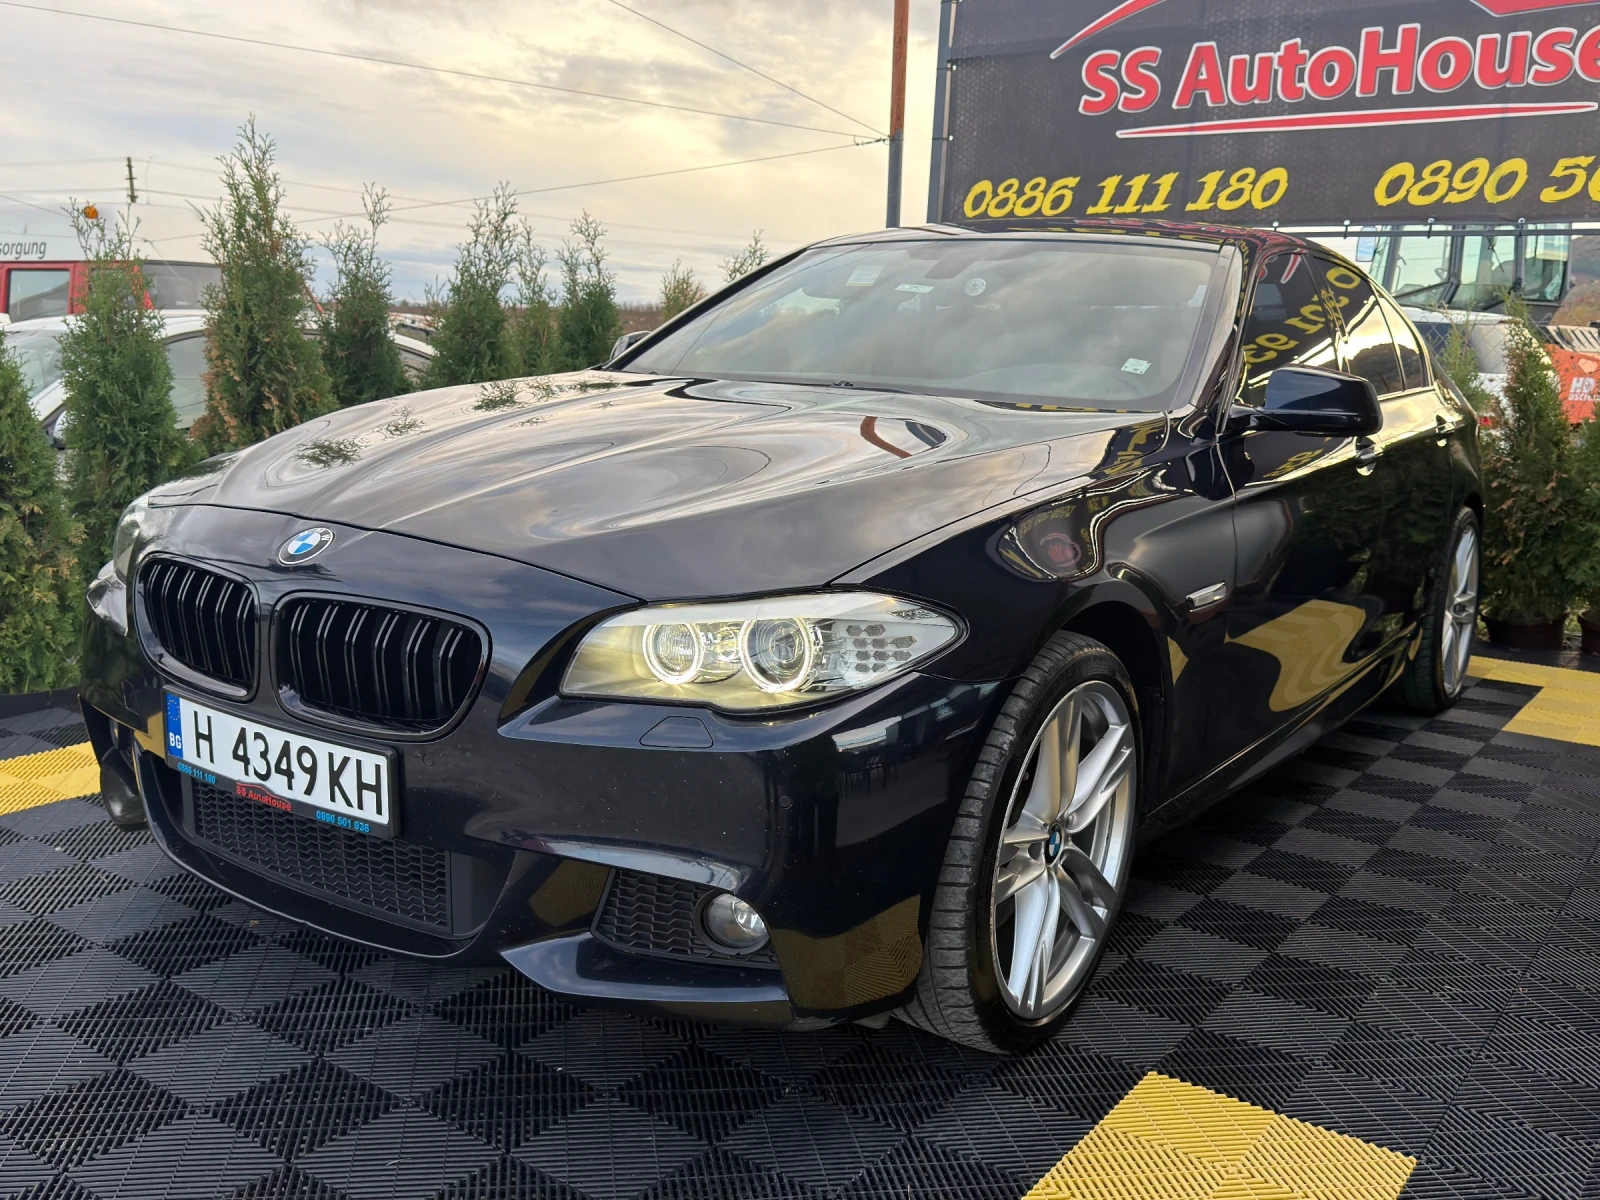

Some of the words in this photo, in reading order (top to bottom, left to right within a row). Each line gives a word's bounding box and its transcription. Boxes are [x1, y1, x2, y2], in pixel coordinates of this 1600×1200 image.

[1078, 45, 1162, 116] SS
[963, 176, 1081, 219] 0886
[1086, 171, 1179, 215] 111
[1185, 167, 1288, 213] 180
[1374, 156, 1528, 207] 0890
[168, 732, 182, 750] BG
[193, 710, 215, 764] H
[232, 726, 318, 796] 4349
[328, 751, 383, 816] KH
[236, 785, 247, 796] SS
[248, 790, 292, 812] AutoHouse
[316, 810, 335, 824] 0890
[337, 816, 352, 828] 501
[354, 821, 370, 833] 938
